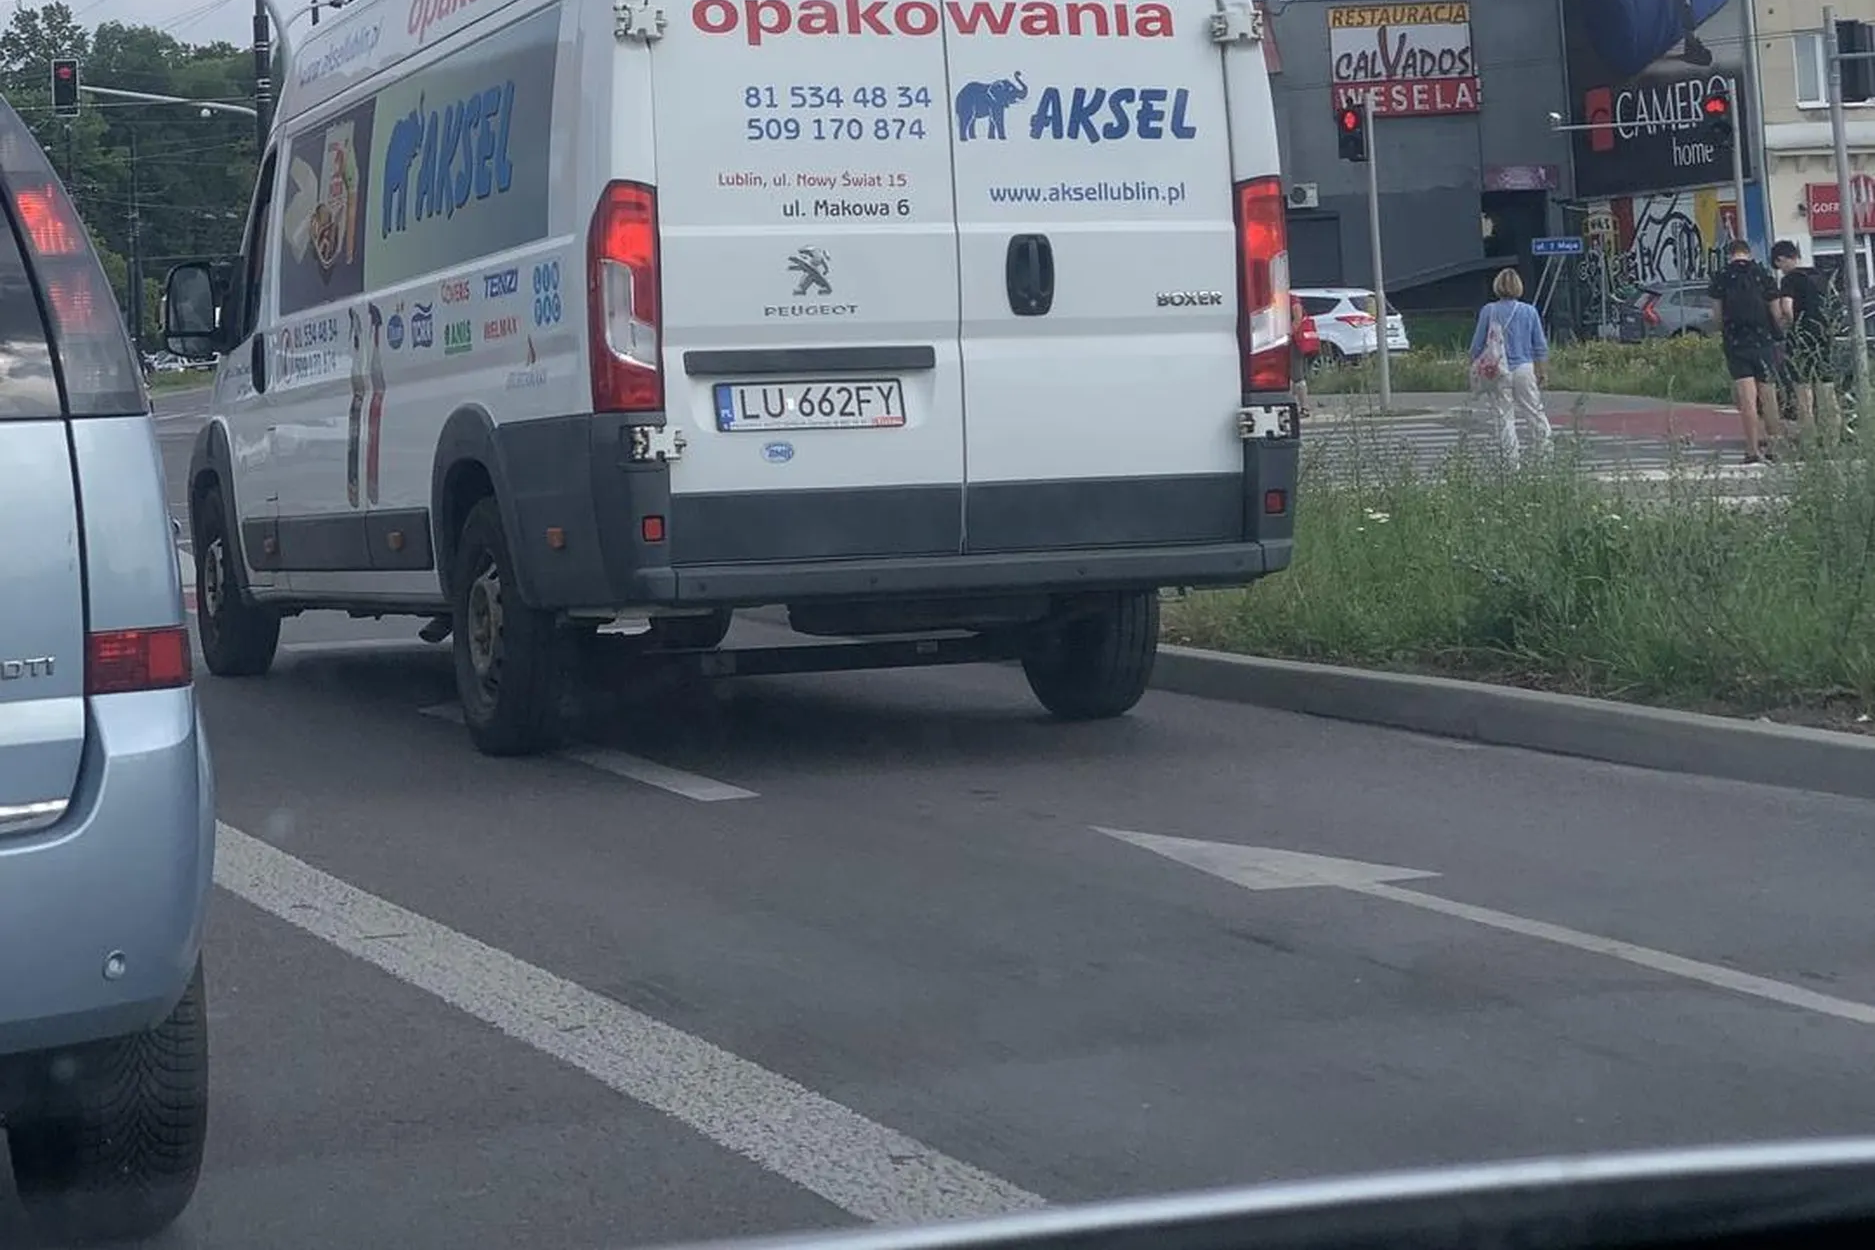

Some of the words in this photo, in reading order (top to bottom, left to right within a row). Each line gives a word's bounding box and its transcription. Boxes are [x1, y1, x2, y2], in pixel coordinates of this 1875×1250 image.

[1332, 4, 1467, 26] RESTAURACJA
[1335, 25, 1470, 81] CALVADOS
[744, 86, 778, 109] 81
[790, 86, 844, 108] 534
[853, 86, 887, 108] 48
[897, 86, 931, 108] 34
[1338, 82, 1475, 112] WESELA
[1030, 87, 1197, 144] AKSEL
[747, 118, 800, 141] 509
[812, 118, 863, 140] 170
[874, 118, 926, 140] 874
[415, 80, 515, 221] AKSEL
[1672, 137, 1714, 167] home
[718, 172, 767, 189] Lublin,
[773, 173, 791, 187] ul.
[797, 173, 837, 190] Nowy
[842, 170, 883, 188] Świat
[888, 173, 908, 187] 15
[990, 182, 1186, 205] www.aksellublin.pl
[782, 200, 806, 217] ul.
[814, 200, 891, 217] Makowa
[897, 199, 911, 217] 6
[484, 266, 519, 298] TENZI
[764, 303, 859, 317] PEUGEOT
[1156, 291, 1223, 307] BOXER
[740, 387, 785, 419] LU
[799, 385, 894, 418] 662FY
